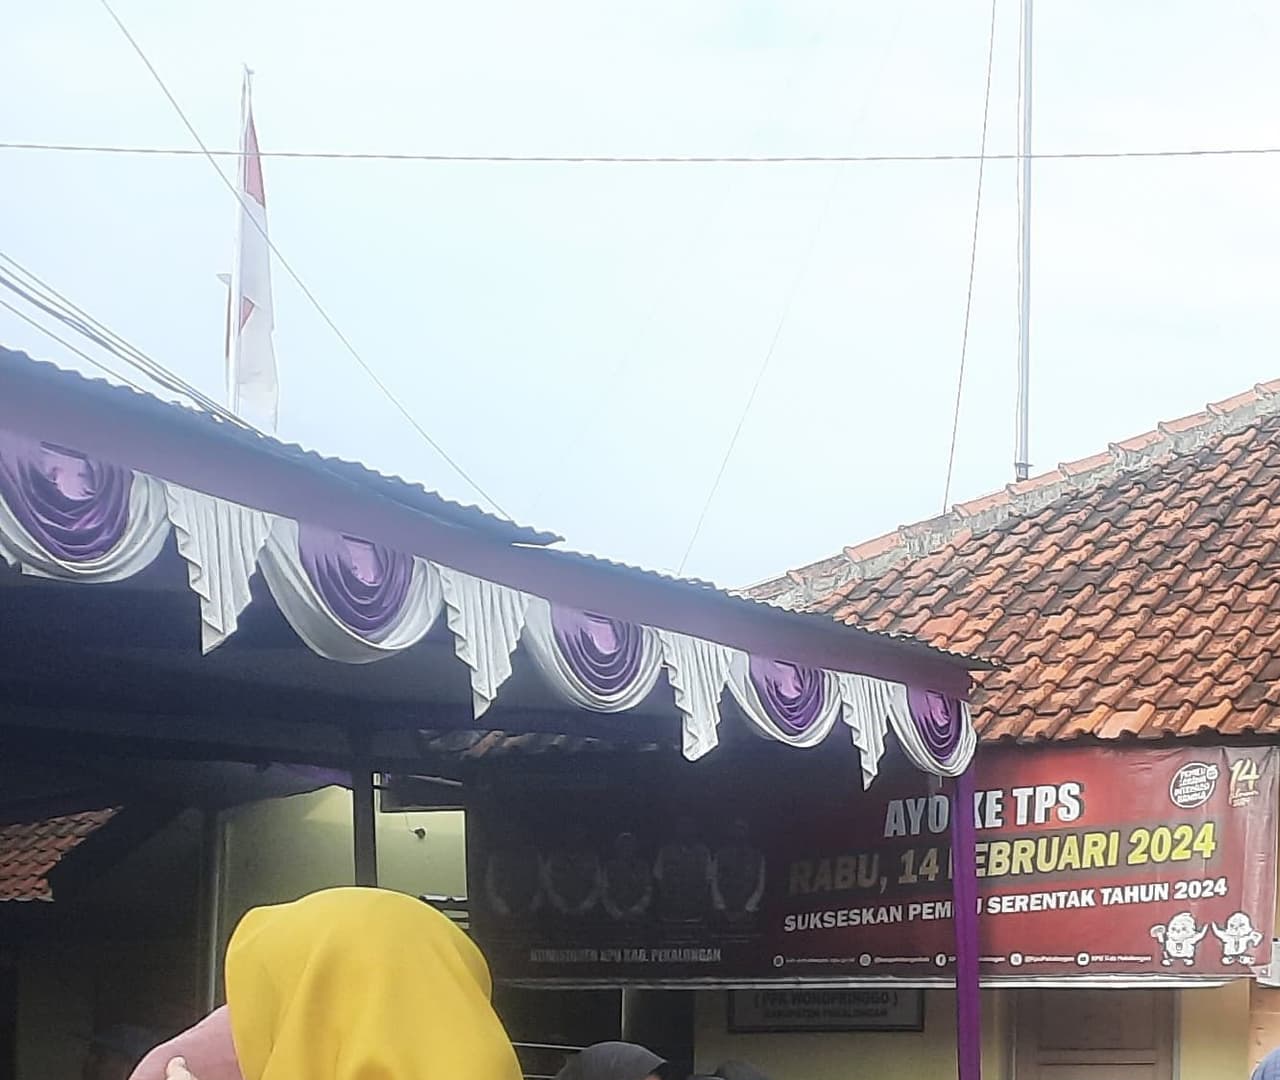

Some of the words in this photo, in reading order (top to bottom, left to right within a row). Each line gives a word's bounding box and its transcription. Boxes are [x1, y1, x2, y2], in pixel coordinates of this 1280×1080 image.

[884, 794, 950, 837] AYO
[1012, 782, 1082, 826] TPS
[789, 853, 888, 895] RABU,
[898, 848, 940, 885] 14
[947, 831, 1121, 880] EBRUARI
[1127, 822, 1217, 866] 2024
[784, 904, 903, 933] SUKSESKAN
[909, 898, 983, 922] PEM
[987, 888, 1096, 915] SERENTAK
[1100, 883, 1169, 906] TAHUN
[1174, 877, 1228, 900] 2024
